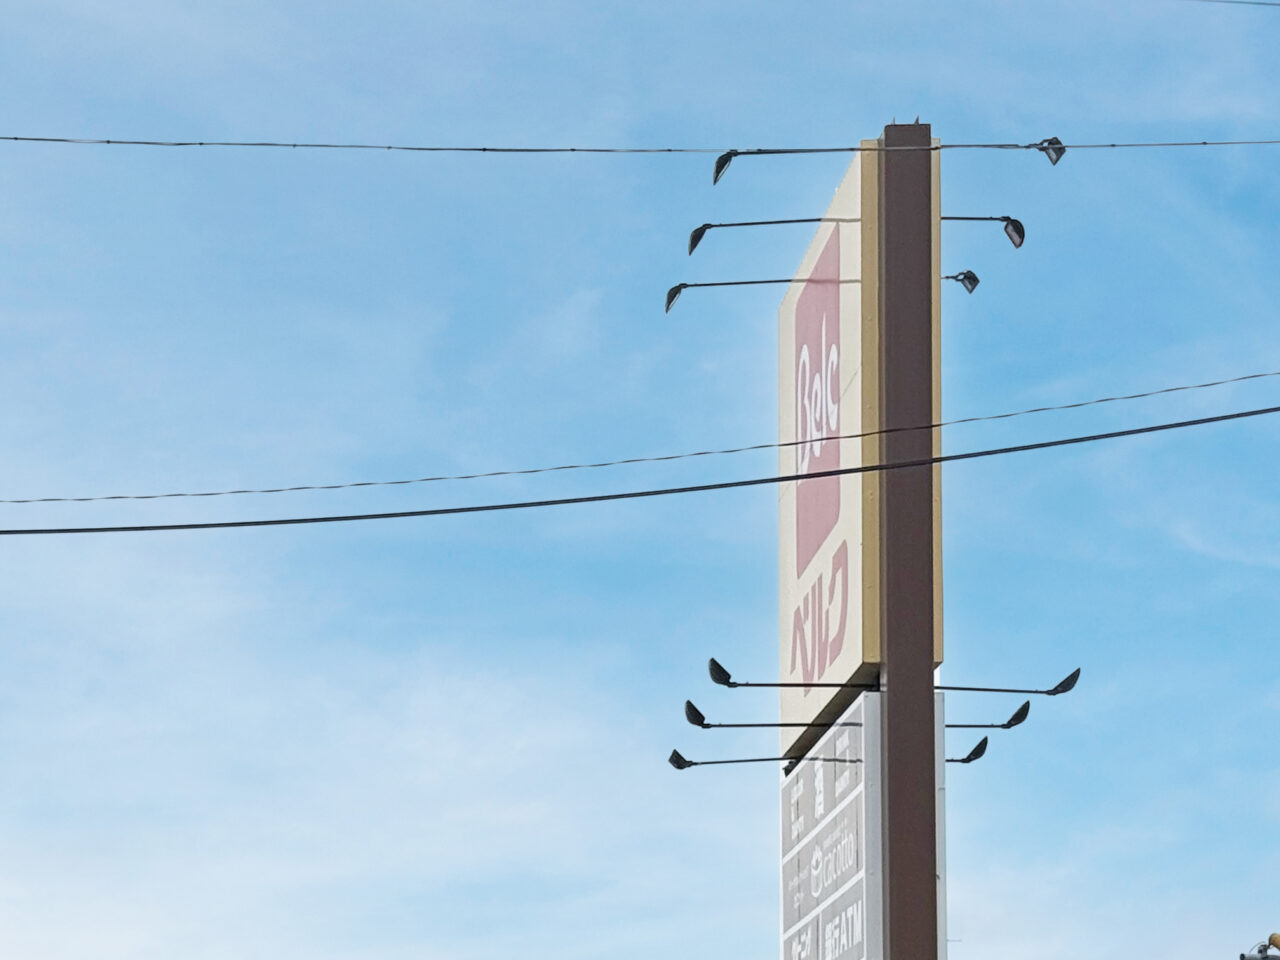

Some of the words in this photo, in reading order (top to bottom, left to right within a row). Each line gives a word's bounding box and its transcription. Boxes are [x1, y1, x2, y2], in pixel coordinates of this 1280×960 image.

[797, 310, 840, 485] Belc
[790, 539, 848, 698] ベルク
